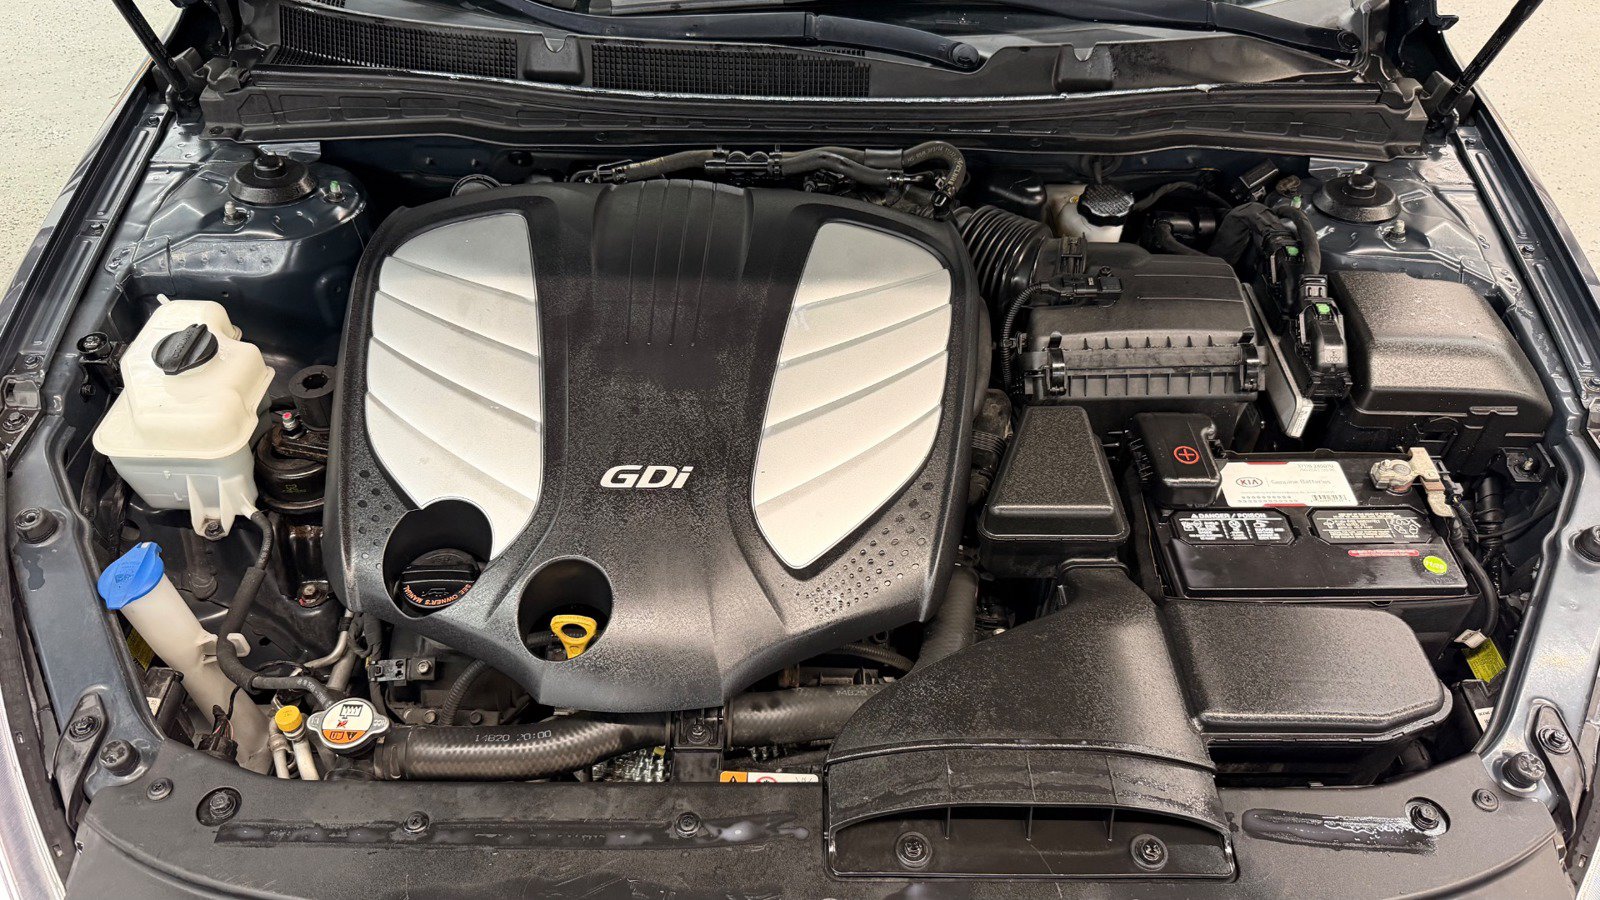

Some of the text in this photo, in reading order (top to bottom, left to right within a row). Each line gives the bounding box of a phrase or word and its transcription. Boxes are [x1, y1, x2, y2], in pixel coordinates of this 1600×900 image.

[600, 464, 694, 489] GDi
[403, 584, 472, 606] SEE OWNER'S MANUAL
